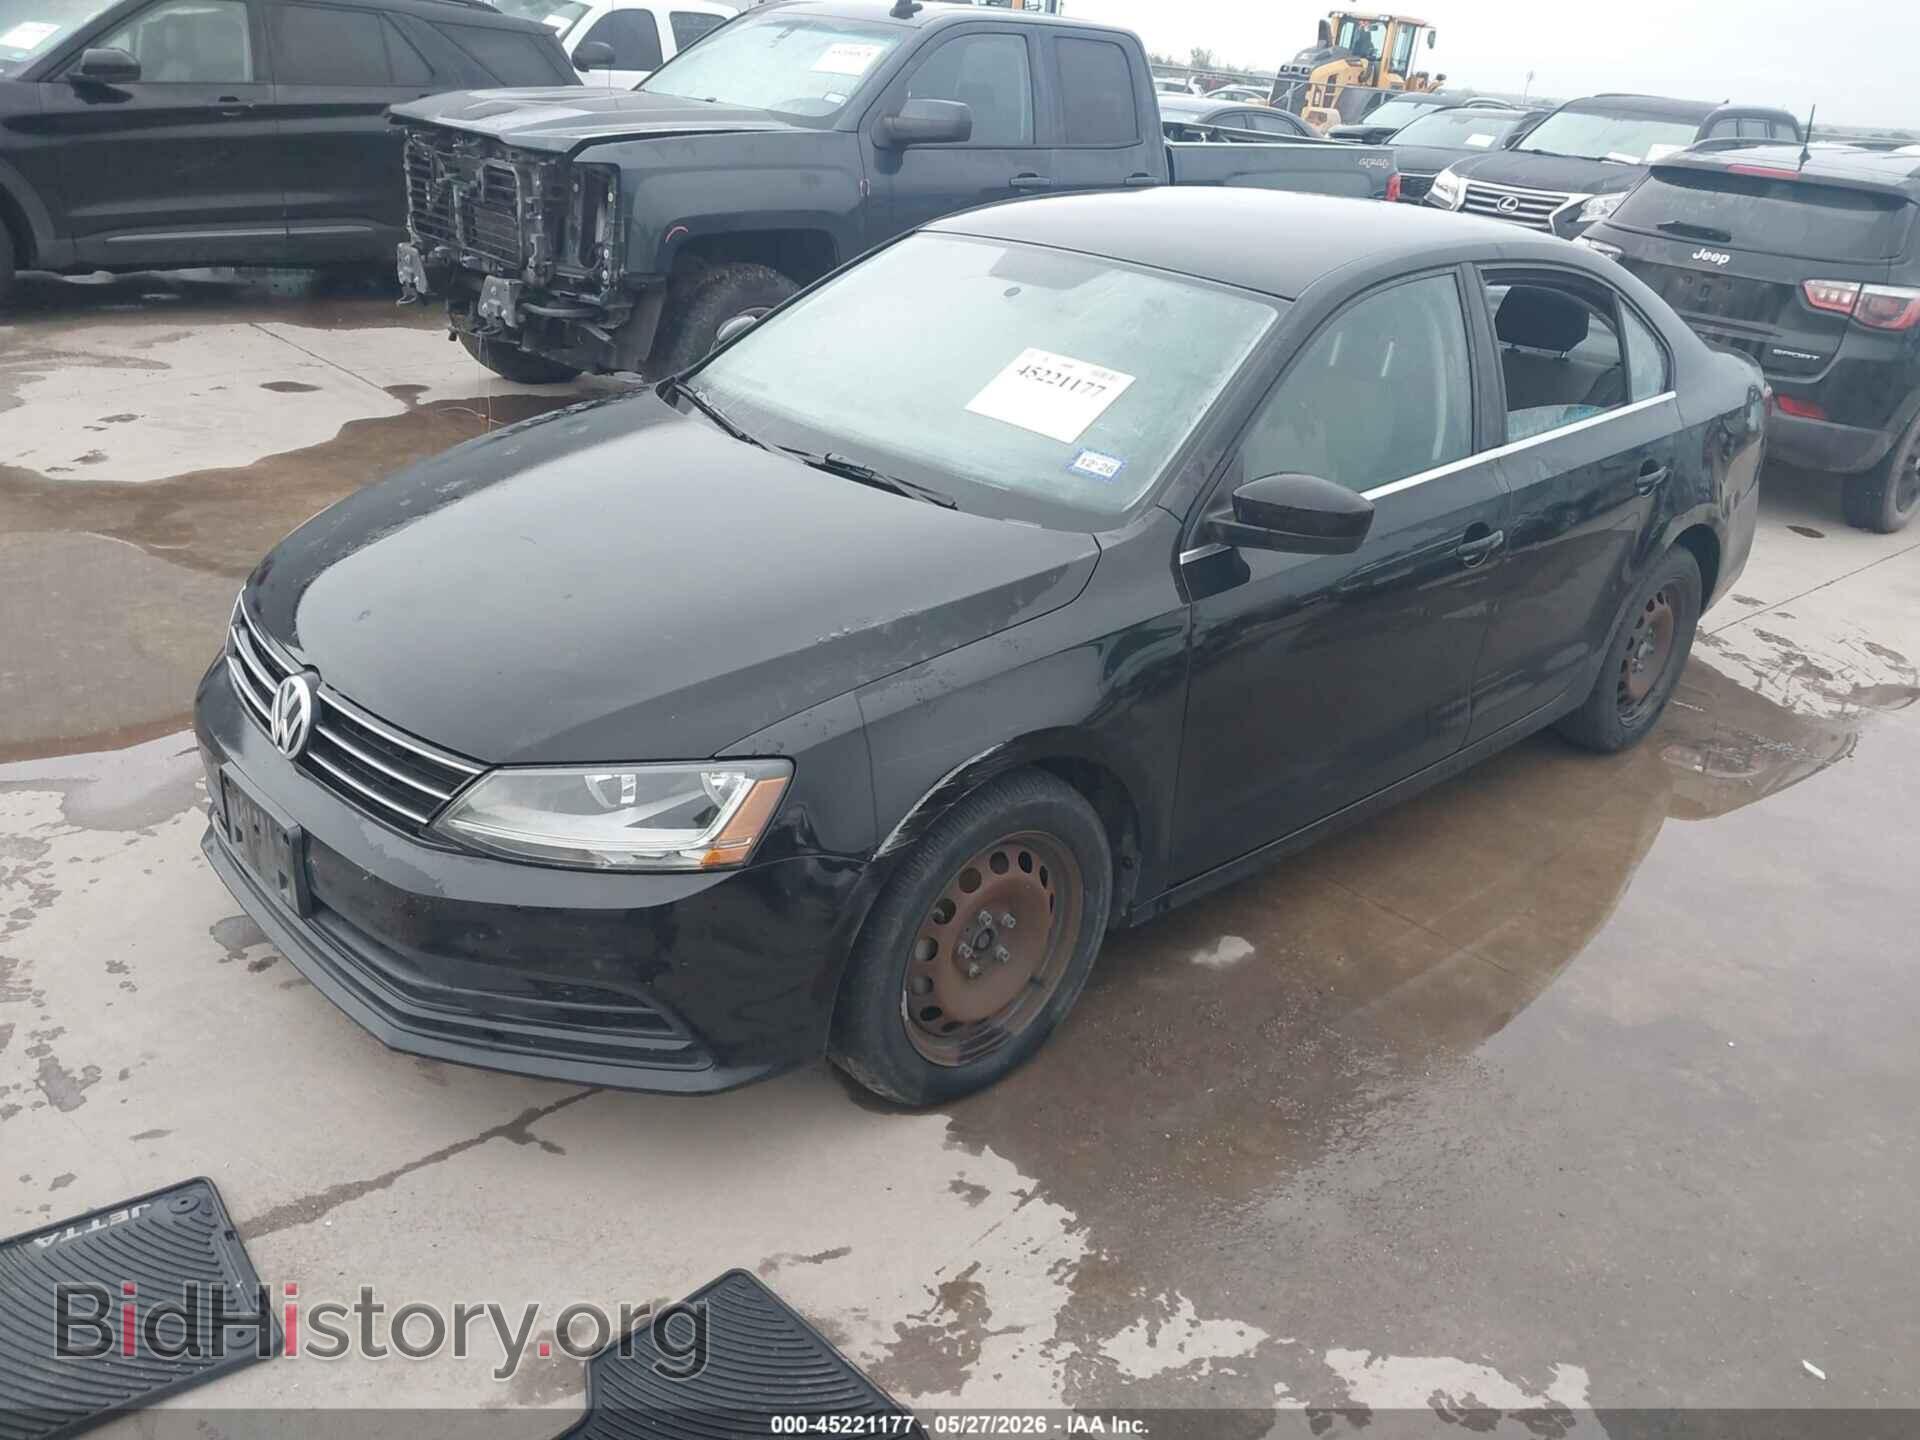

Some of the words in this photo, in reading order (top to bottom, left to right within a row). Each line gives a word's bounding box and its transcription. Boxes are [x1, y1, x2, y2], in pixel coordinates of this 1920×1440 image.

[1692, 248, 1730, 265] Jeep
[1773, 348, 1820, 360] SPORT
[1016, 365, 1107, 397] 45221177
[33, 1203, 151, 1248] JETTA
